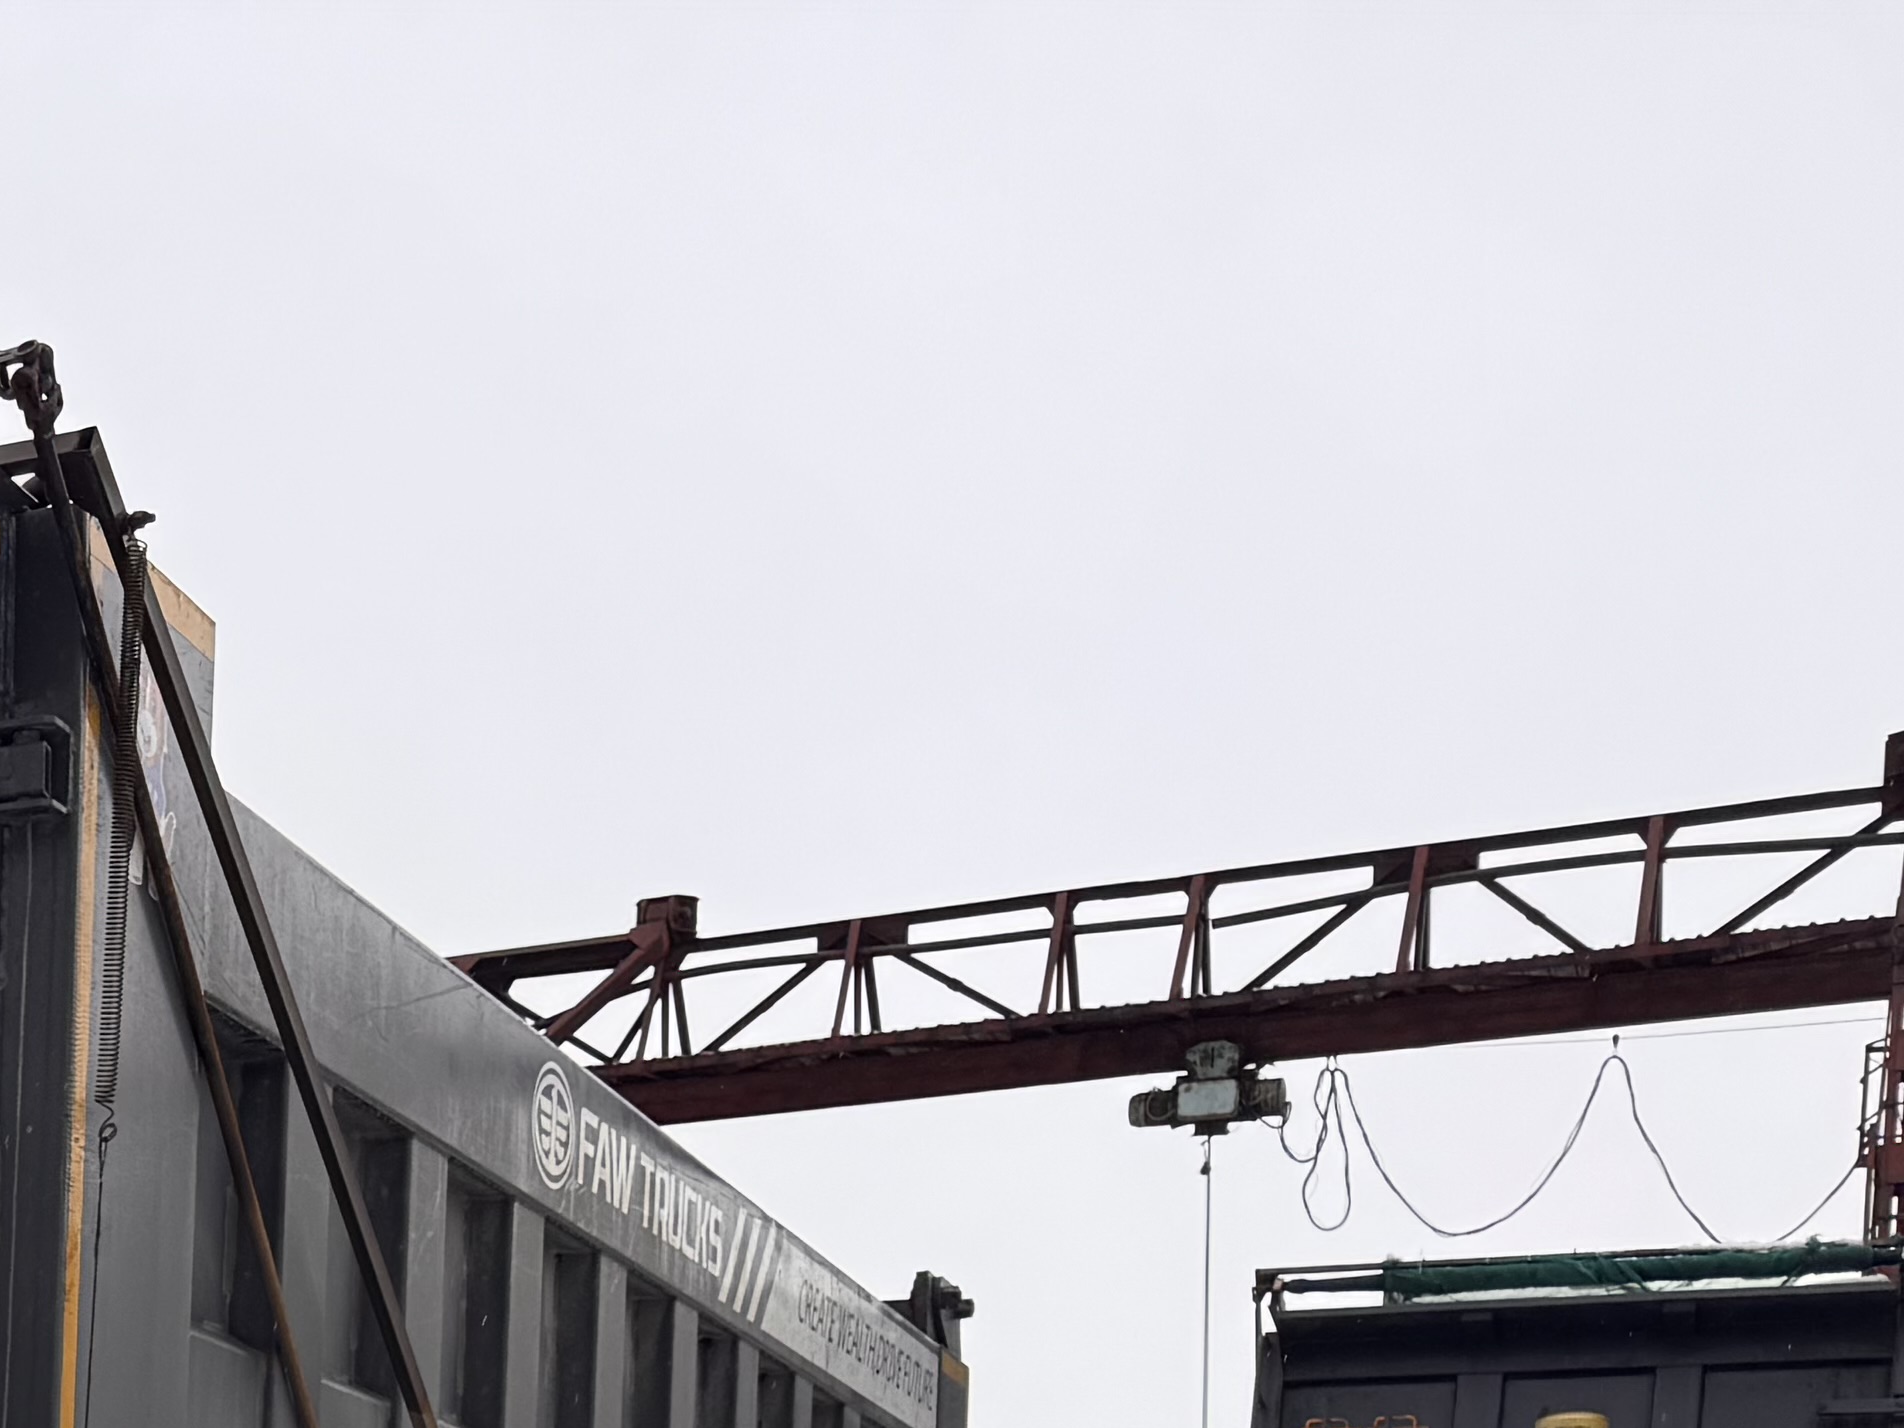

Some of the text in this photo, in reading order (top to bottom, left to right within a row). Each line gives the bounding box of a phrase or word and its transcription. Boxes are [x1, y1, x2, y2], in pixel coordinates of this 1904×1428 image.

[578, 1107, 723, 1277] FAW TRUCKS
[798, 1279, 838, 1343] CREATE
